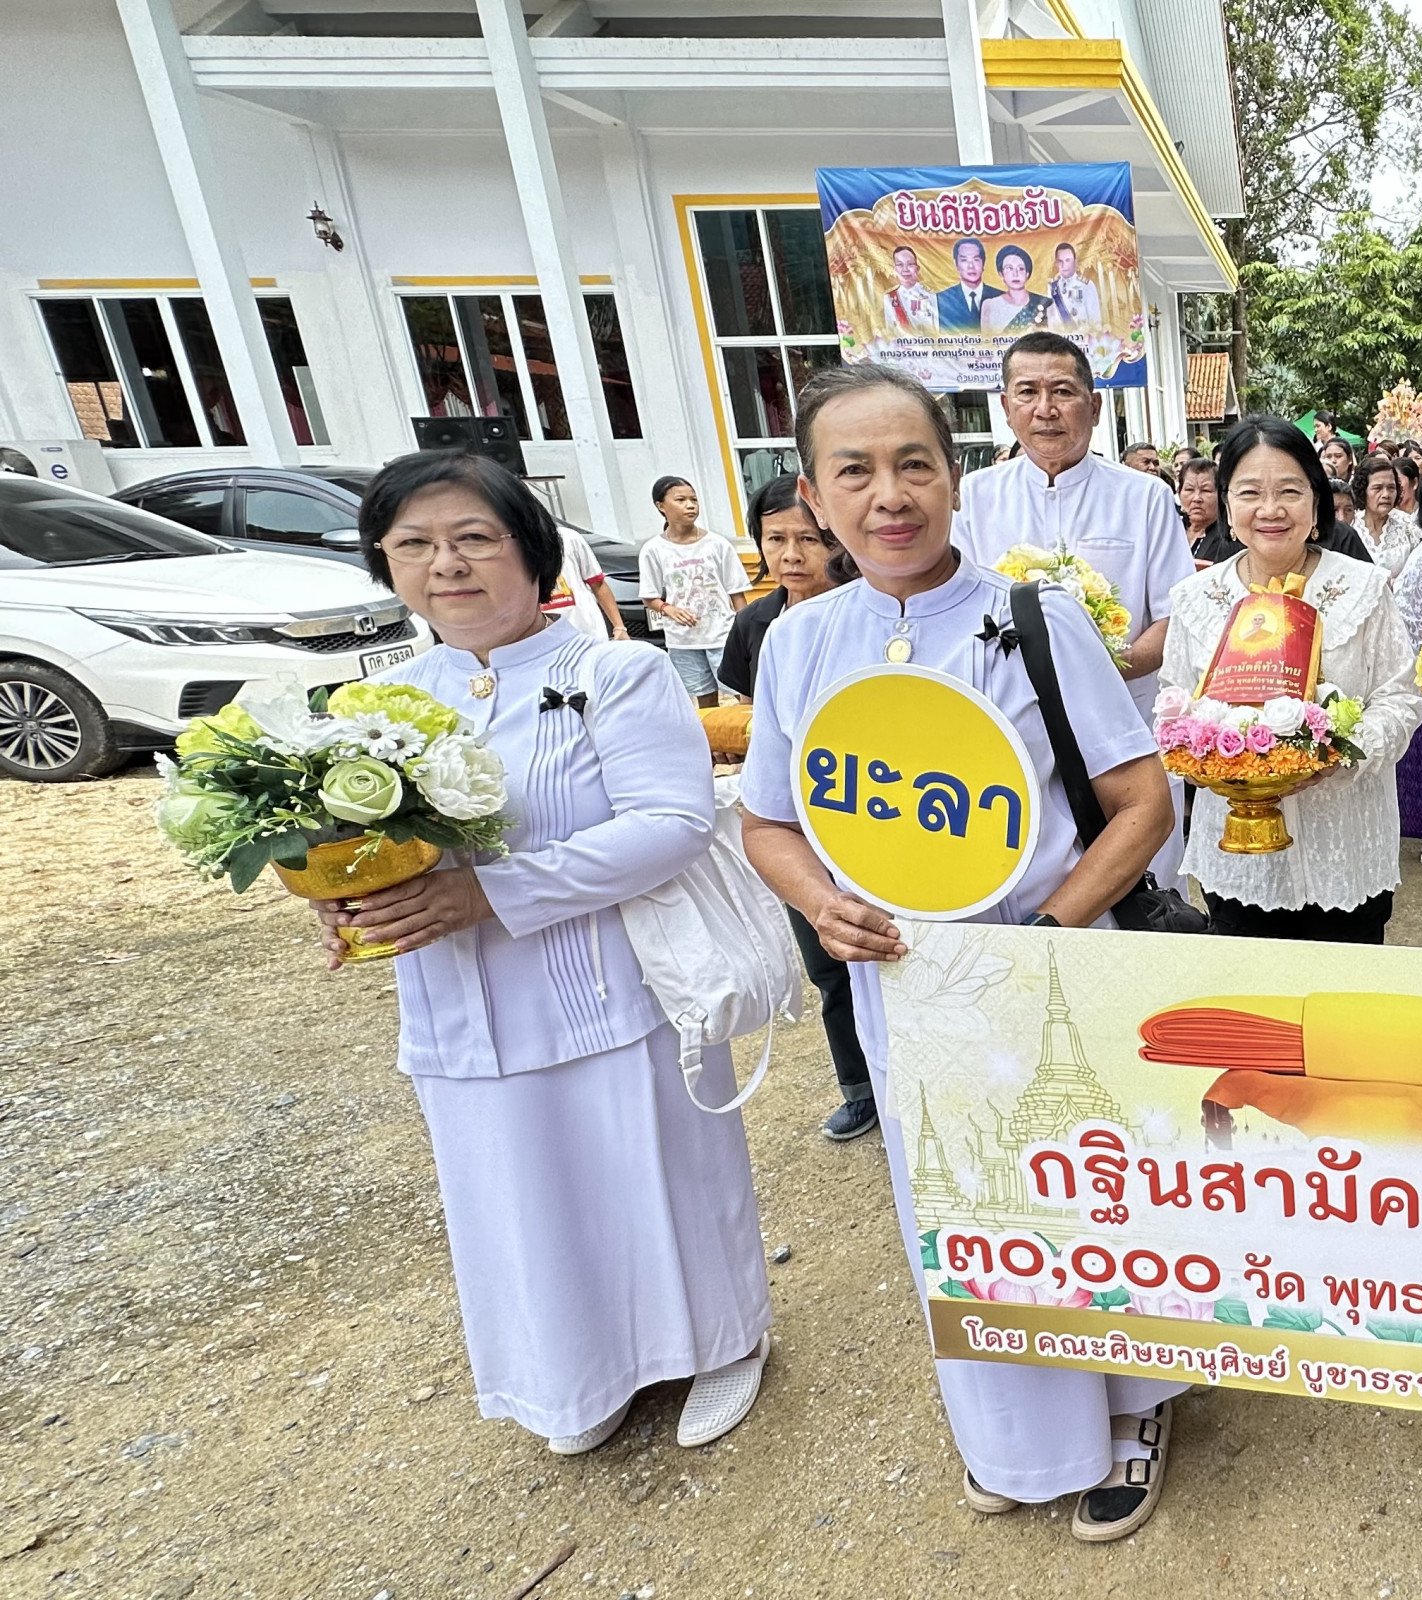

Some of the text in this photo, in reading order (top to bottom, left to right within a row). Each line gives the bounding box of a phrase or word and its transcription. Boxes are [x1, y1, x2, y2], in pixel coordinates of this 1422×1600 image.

[896, 187, 1061, 232] ยินดีต้อนรับ
[806, 748, 1022, 850] ยะลา
[946, 1234, 1221, 1293] ๓๐,๐๐๐
[1244, 1252, 1306, 1303] วัด
[965, 1319, 1025, 1351] โดย
[1038, 1331, 1286, 1381] คณะศิษยานุศิษย์
